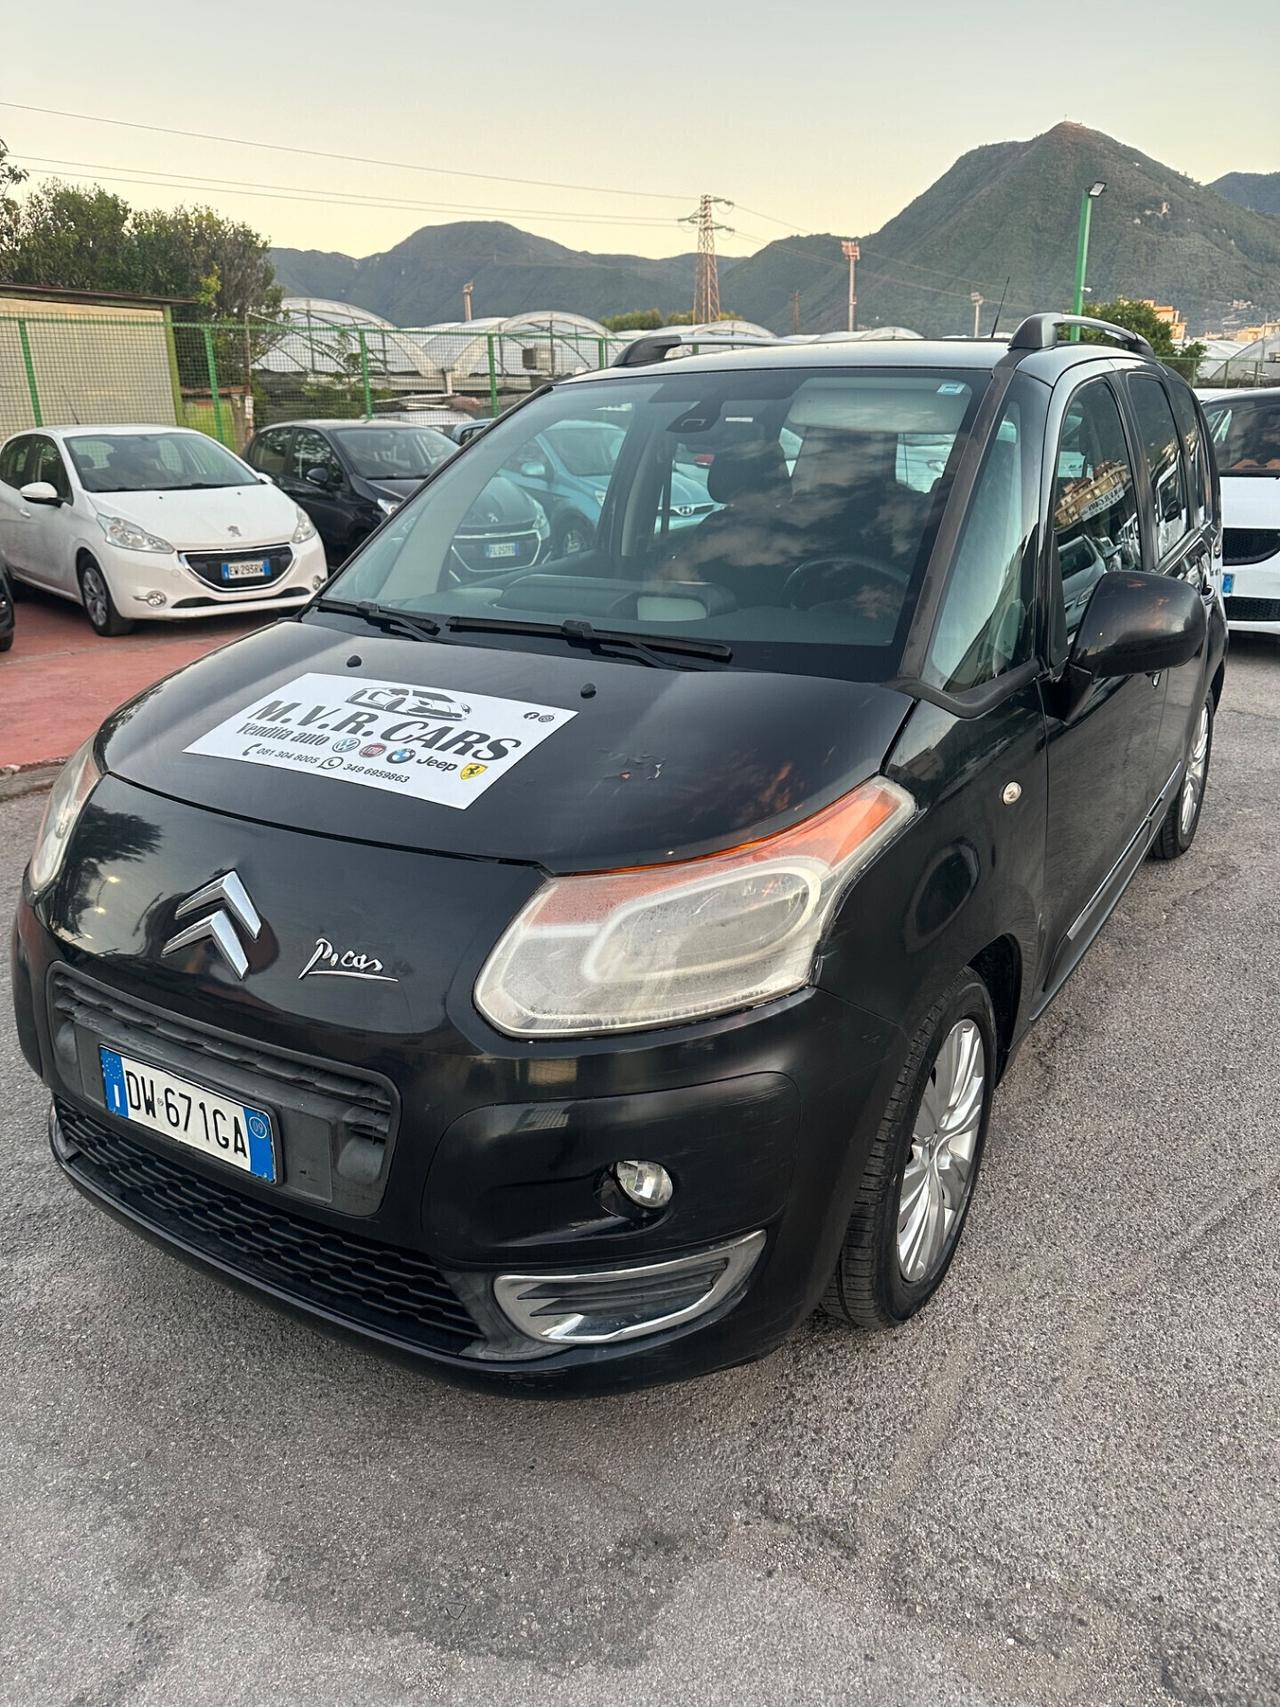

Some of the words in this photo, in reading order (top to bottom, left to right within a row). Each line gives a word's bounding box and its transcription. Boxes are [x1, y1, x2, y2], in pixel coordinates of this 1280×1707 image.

[236, 722, 294, 741] Vendita
[290, 731, 330, 746] auto
[256, 747, 274, 756] 081
[274, 750, 293, 760] 304
[293, 753, 320, 764] 8005
[416, 755, 458, 772] Jeep
[343, 763, 364, 774] 349
[364, 767, 410, 783] 6959863
